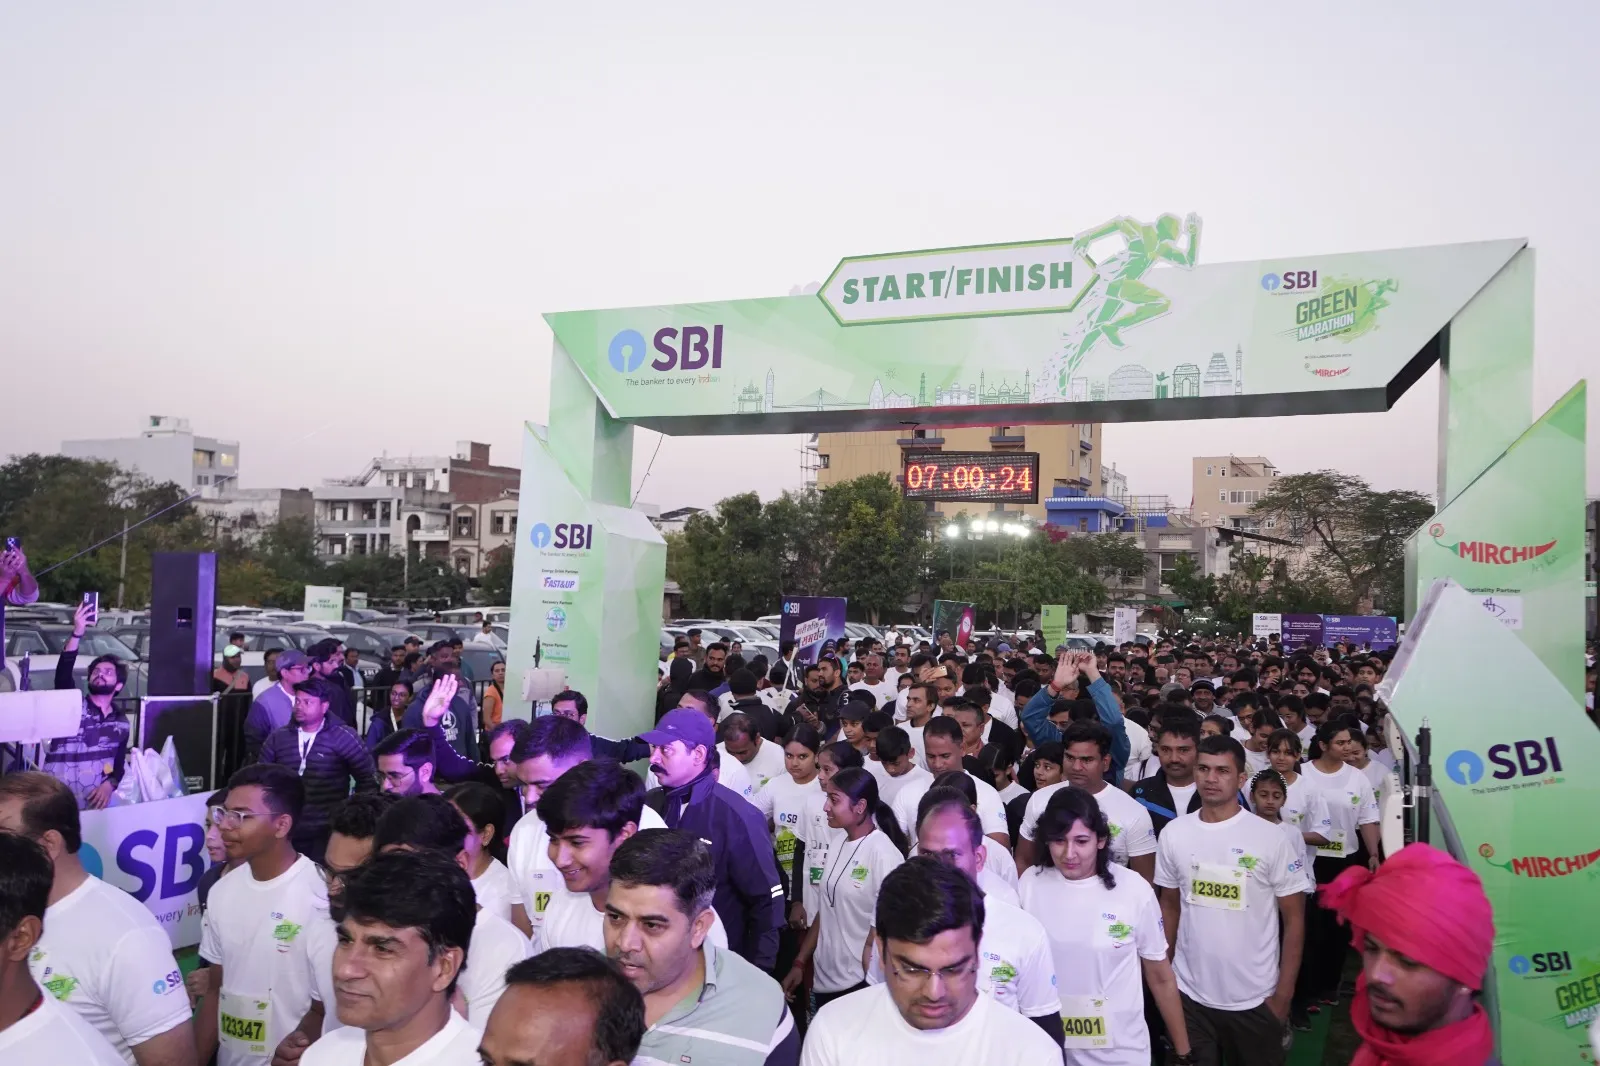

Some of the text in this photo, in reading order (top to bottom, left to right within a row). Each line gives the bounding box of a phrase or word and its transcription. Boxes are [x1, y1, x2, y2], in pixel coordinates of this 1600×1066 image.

[842, 261, 1073, 305] START/FINISH
[1282, 269, 1318, 290] SBI
[1295, 285, 1358, 325] GREEN
[1299, 312, 1354, 341] MARATHON
[650, 324, 724, 372] SBI
[625, 378, 639, 387] The
[640, 377, 665, 386] banker
[667, 377, 675, 385] to
[675, 376, 696, 386] every
[1314, 368, 1344, 378] MIRCHI
[906, 464, 1033, 491] 07:00:24
[553, 523, 593, 550] SBI
[1459, 541, 1535, 565] MIRCHI
[789, 602, 800, 614] SBI
[1487, 736, 1563, 780] SBI
[786, 813, 798, 824] SB
[115, 822, 206, 904] SB
[1511, 854, 1588, 878] MIRCHI
[1192, 879, 1239, 899] 123823
[1531, 950, 1573, 973] SBI
[165, 969, 181, 988] SB
[1555, 972, 1600, 1011] GREE
[1064, 1018, 1102, 1035] 4001
[1565, 1002, 1600, 1029] MARA
